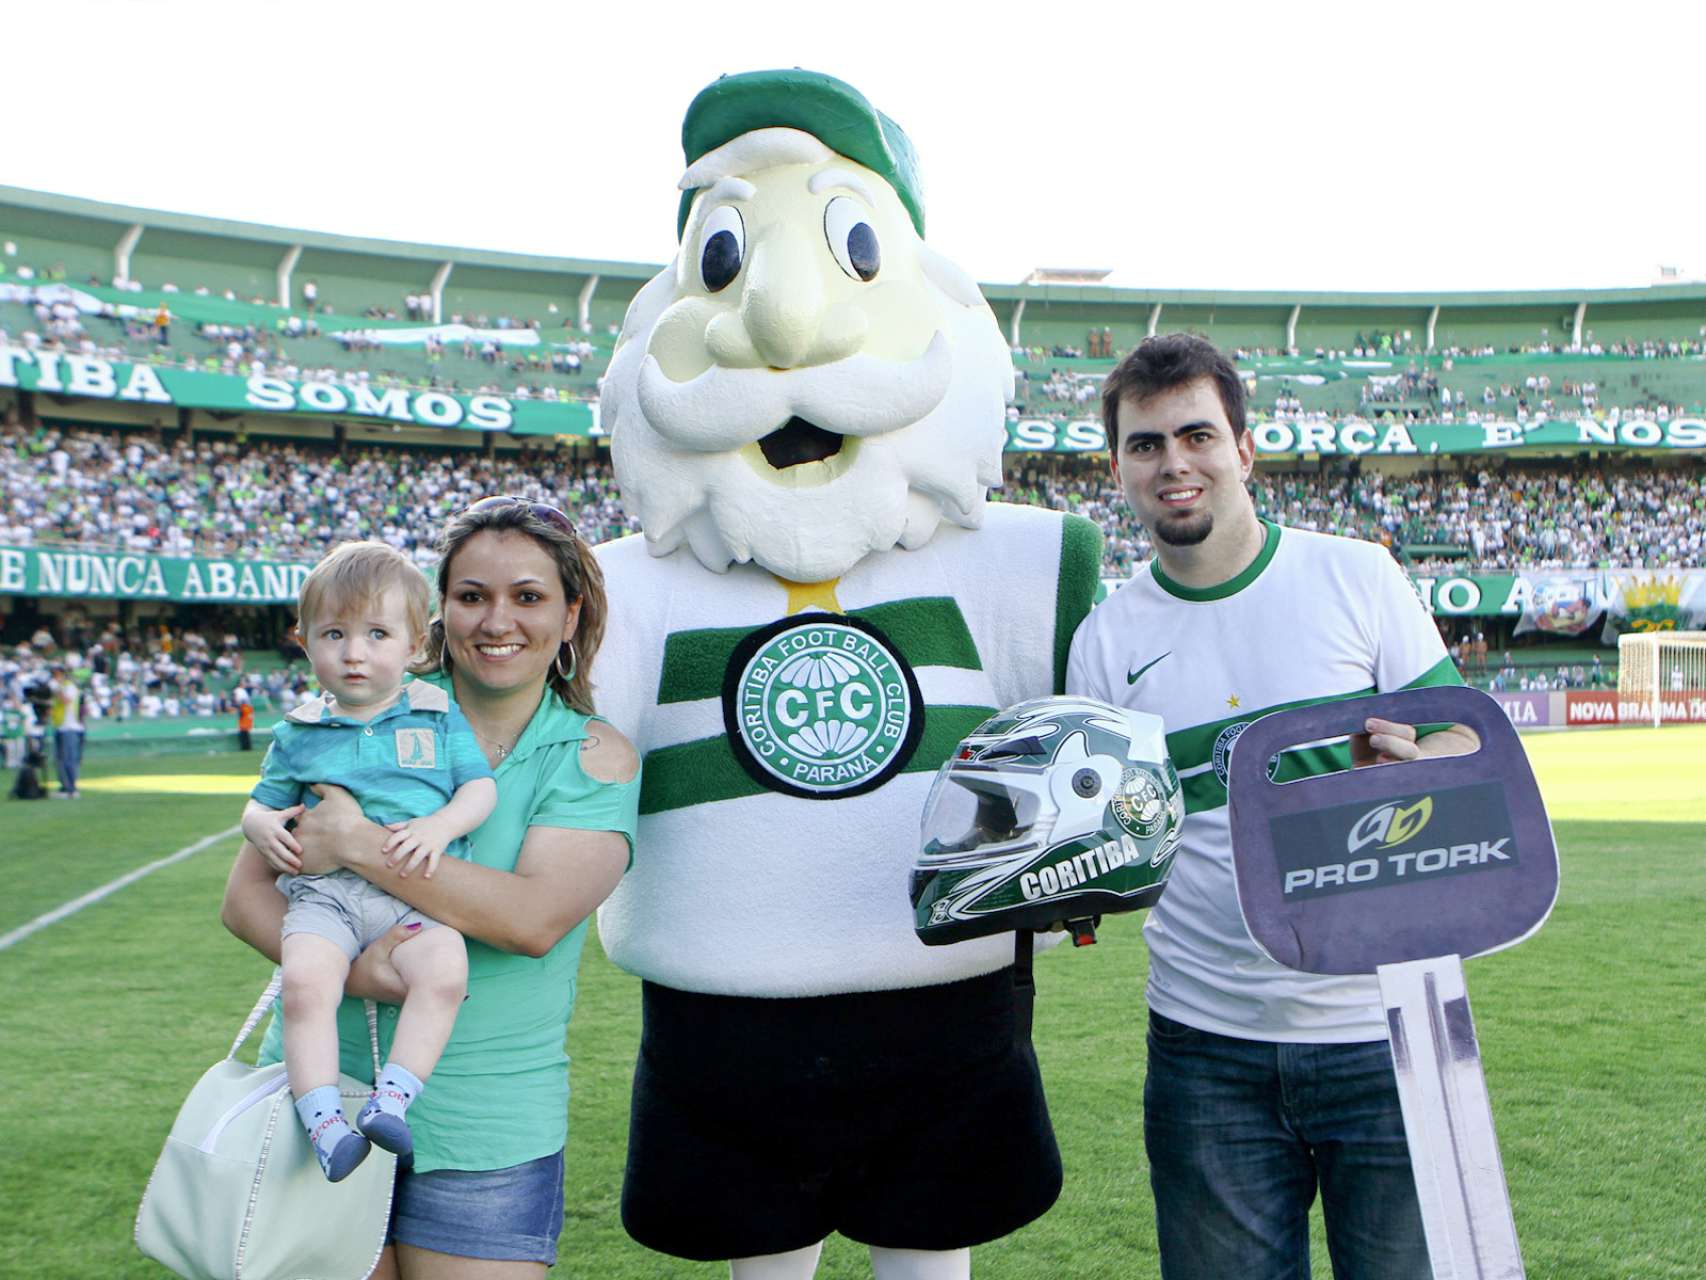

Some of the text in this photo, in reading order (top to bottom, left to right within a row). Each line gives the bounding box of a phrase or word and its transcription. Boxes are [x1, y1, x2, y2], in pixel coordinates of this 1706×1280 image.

[246, 375, 512, 430] SOMOS
[1576, 417, 1706, 448] NOS
[37, 552, 168, 596] NUNCA
[744, 630, 904, 756] CORITIBA FOOT BALL CLUB
[775, 682, 873, 728] CFC
[1570, 701, 1615, 721] NOVA
[792, 752, 878, 782] PARANÁ
[1131, 783, 1157, 812] CFC
[1019, 833, 1140, 900] CORITIBA
[1284, 838, 1511, 893] PRO TORK
